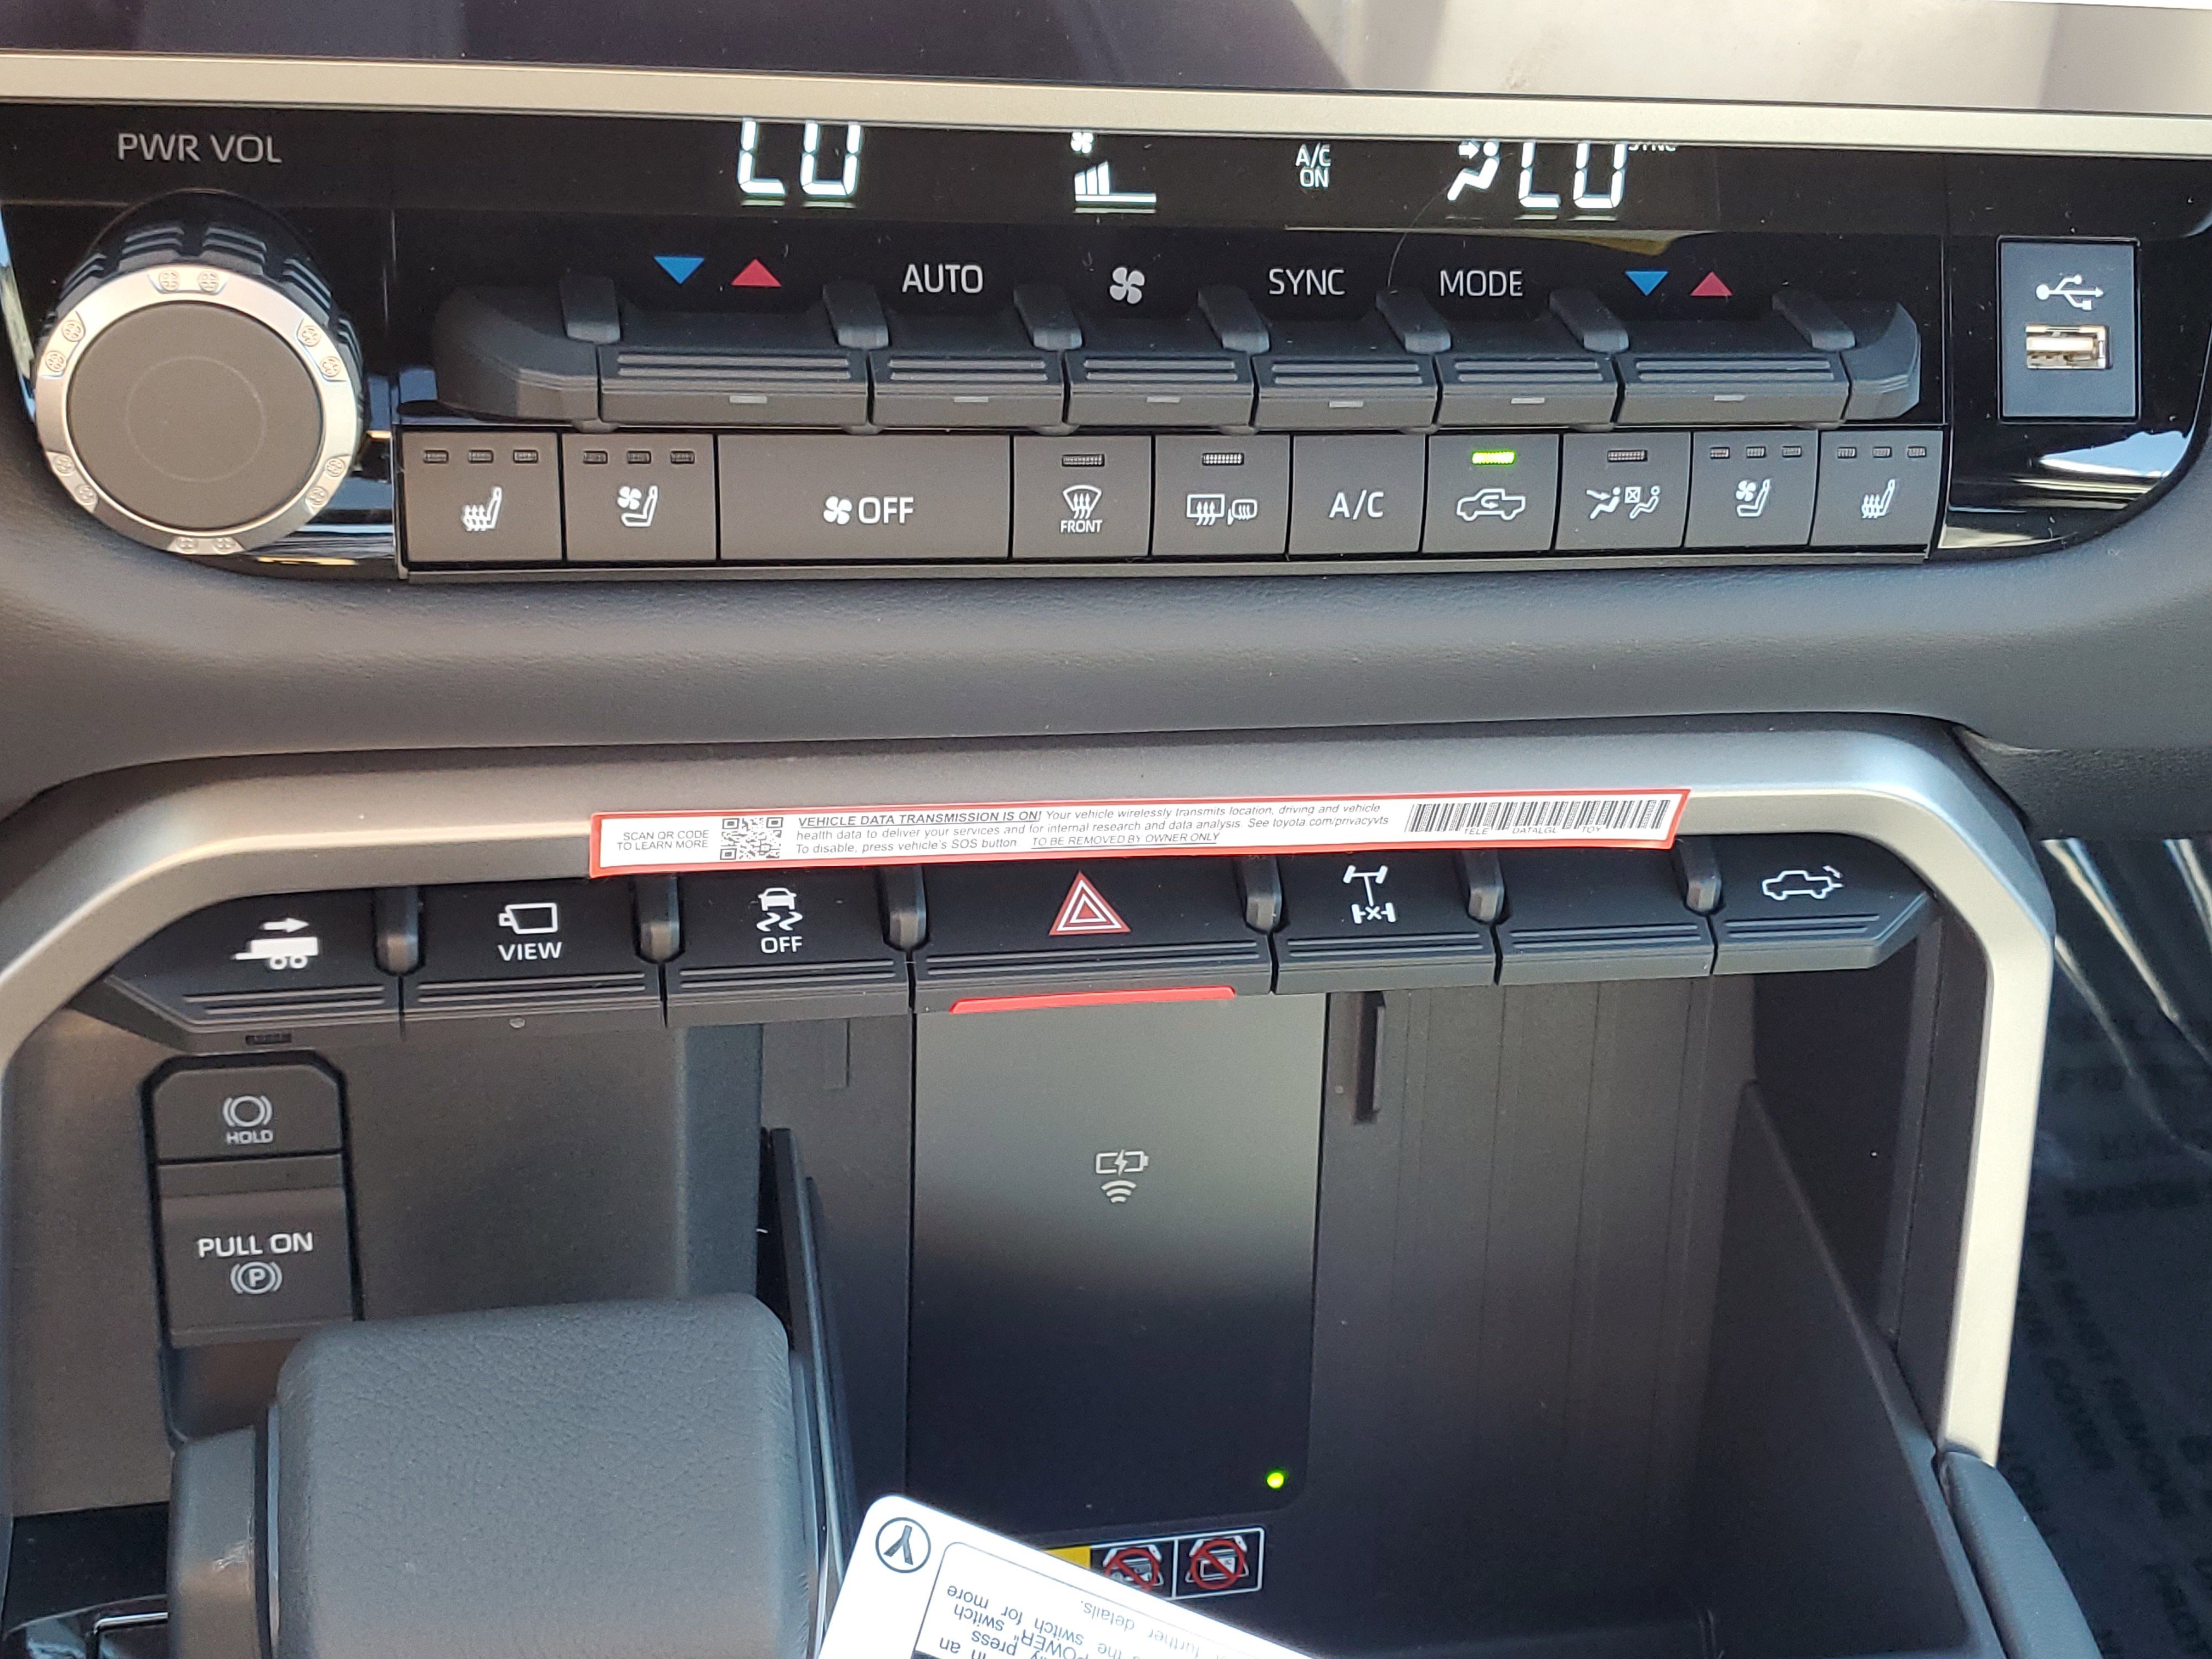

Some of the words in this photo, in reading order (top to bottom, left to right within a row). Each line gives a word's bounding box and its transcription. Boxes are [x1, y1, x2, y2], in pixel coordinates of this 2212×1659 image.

[117, 132, 201, 162] PWR
[210, 134, 281, 164] VOL
[1295, 144, 1331, 167] A/C
[1300, 167, 1329, 188] ON
[902, 264, 984, 294] AUTO
[1269, 268, 1345, 297] SYNC
[1440, 269, 1524, 297] MODE
[857, 495, 915, 526] OFF
[1329, 490, 1384, 520] A/C
[1060, 518, 1103, 534] FRONT
[798, 816, 856, 826] VEHICLE
[860, 815, 895, 825] DATA
[900, 812, 998, 823] TRANSMISSION
[1003, 812, 1015, 821] IS
[1046, 810, 1071, 820] Your
[1075, 809, 1114, 819] vehicle
[1118, 808, 1172, 819] wirelessly
[1176, 806, 1225, 816] transmits
[1278, 805, 1315, 816] driving
[1318, 804, 1340, 814] and
[1344, 803, 1380, 812] vehicle
[623, 831, 654, 840] SCAN
[658, 831, 674, 840] QR
[678, 830, 709, 839] CODE
[797, 831, 832, 840] health
[837, 830, 861, 839] data
[867, 829, 877, 838] to
[882, 828, 920, 838] deliver
[924, 828, 949, 839] your
[953, 826, 1000, 836] services
[1004, 825, 1025, 834] and
[1030, 824, 1044, 833] for
[1047, 823, 1089, 833] internal
[1092, 821, 1141, 832] research
[1144, 821, 1166, 830] and
[1169, 820, 1192, 830] data
[1248, 818, 1269, 828] See
[617, 842, 631, 850] TO
[635, 840, 672, 850] LEARN
[675, 840, 708, 848] MORE
[796, 844, 809, 853] To
[862, 843, 894, 854] press
[898, 840, 947, 850] vehicle's
[951, 838, 978, 849] SOS
[1033, 837, 1047, 846] TO
[1050, 837, 1064, 845] BE
[1068, 834, 1125, 845] REMOVED
[1127, 834, 1141, 844] BY
[1146, 833, 1188, 843] OWNER
[1190, 832, 1220, 842] ONLY
[497, 941, 562, 961] VIEW
[760, 936, 803, 953] OFF
[226, 1130, 274, 1145] HOLD
[197, 1235, 263, 1258] PULL
[270, 1232, 313, 1253] ON
[947, 1585, 989, 1609] more
[954, 1604, 1005, 1631] switch
[1001, 1606, 1023, 1626] for
[1081, 1600, 1135, 1632] details.
[972, 1630, 1018, 1656] press
[1035, 1618, 1084, 1645] switch
[939, 1637, 961, 1654] an
